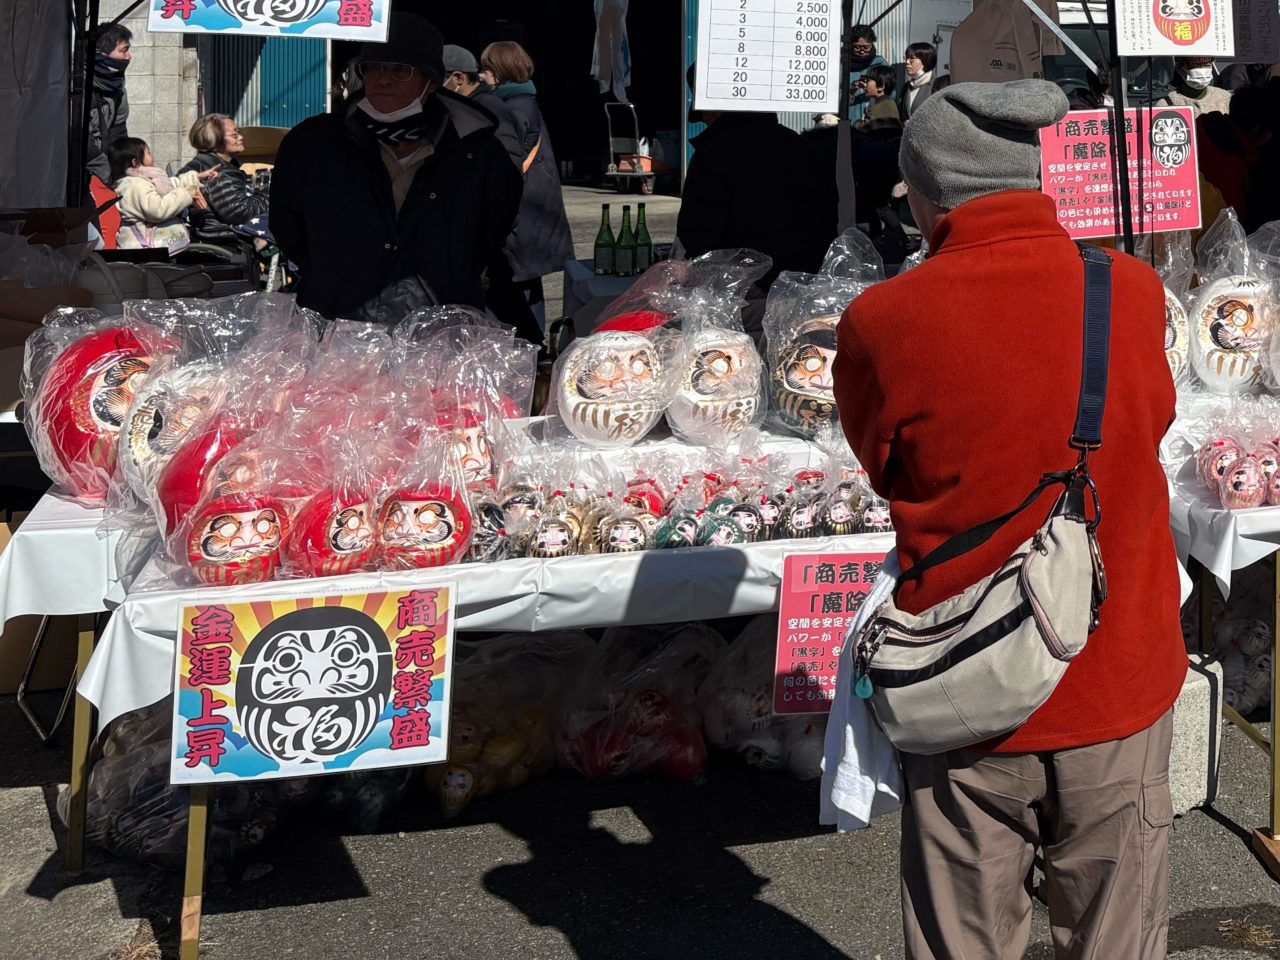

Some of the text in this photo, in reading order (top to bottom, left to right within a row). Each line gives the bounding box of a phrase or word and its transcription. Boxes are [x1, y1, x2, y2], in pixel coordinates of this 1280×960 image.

[740, 0, 829, 13] 2 2,500
[739, 14, 828, 28] 3 4,000
[738, 28, 828, 42] 5 6,000
[1174, 21, 1193, 41] 福
[737, 42, 827, 57] 8 8,800
[735, 57, 827, 71] 12 12,000
[733, 71, 826, 86] 20 22,000
[732, 87, 825, 100] 30 33,000
[389, 590, 438, 751] 商売繁盛
[184, 605, 235, 768] 金運上昇
